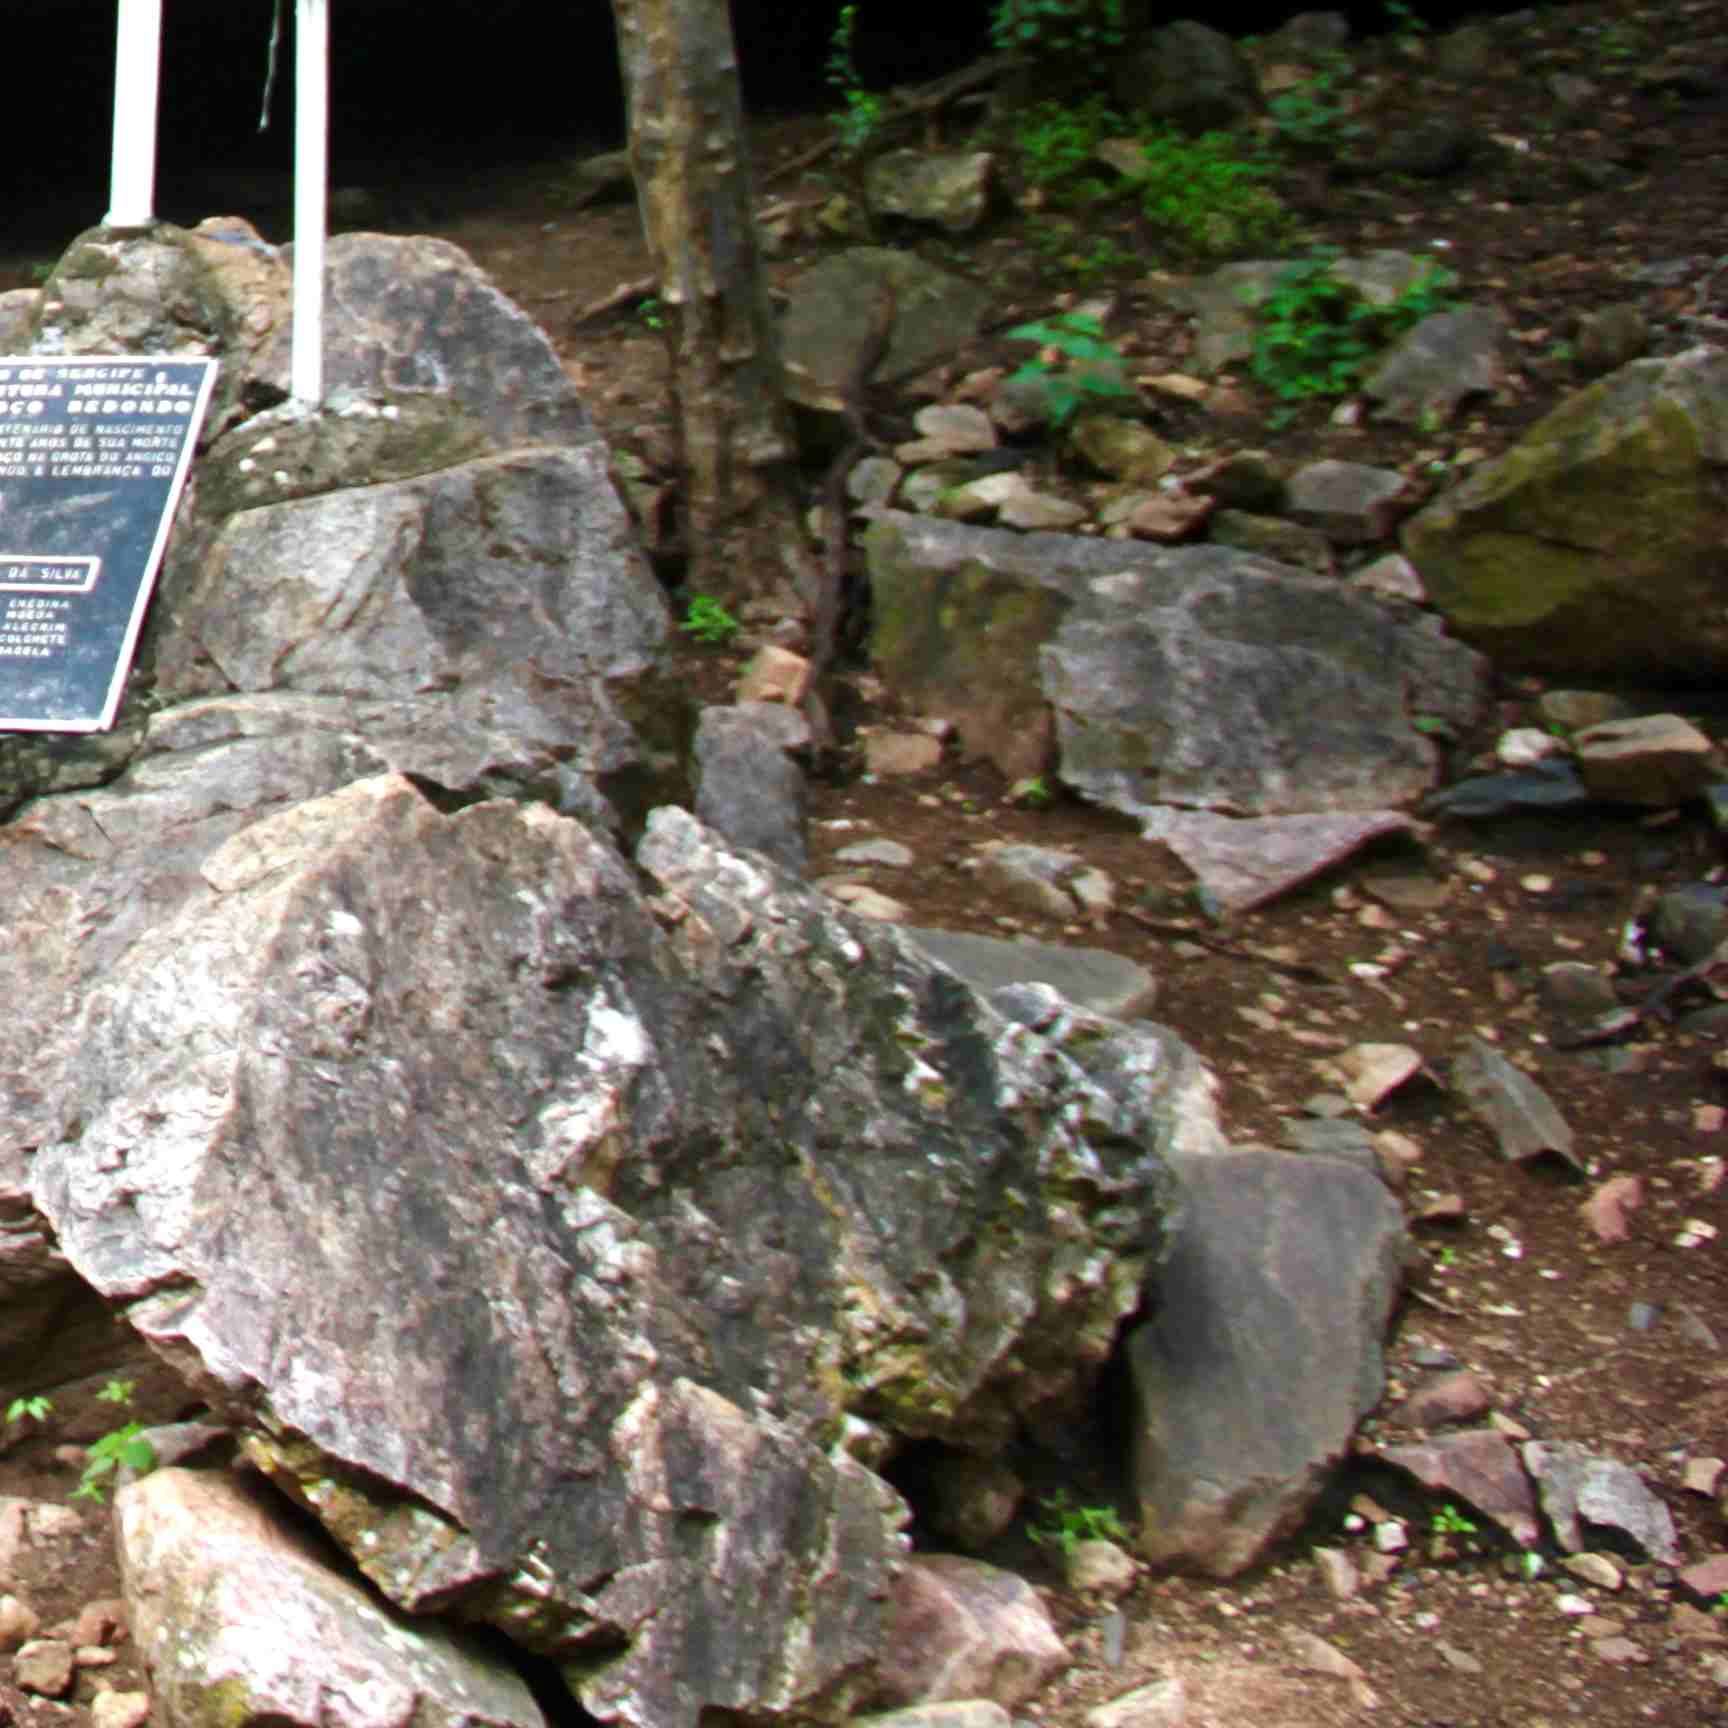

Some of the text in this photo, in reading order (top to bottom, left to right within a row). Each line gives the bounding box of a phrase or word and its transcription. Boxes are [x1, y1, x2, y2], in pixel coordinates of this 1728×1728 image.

[17, 367, 45, 381] DE
[55, 367, 145, 380] SERGIPE
[73, 383, 193, 397] MUNICIPAL
[66, 399, 192, 414] REDONDO
[68, 423, 89, 435] DE
[95, 423, 184, 435] NASCIMENTO
[28, 438, 67, 449] ANOS
[97, 438, 126, 449] SUA
[131, 437, 178, 449] MORTE
[8, 566, 28, 579] DA
[40, 567, 81, 580] SILVA
[8, 598, 71, 609] ENEDINA
[5, 609, 55, 620] MOEDA
